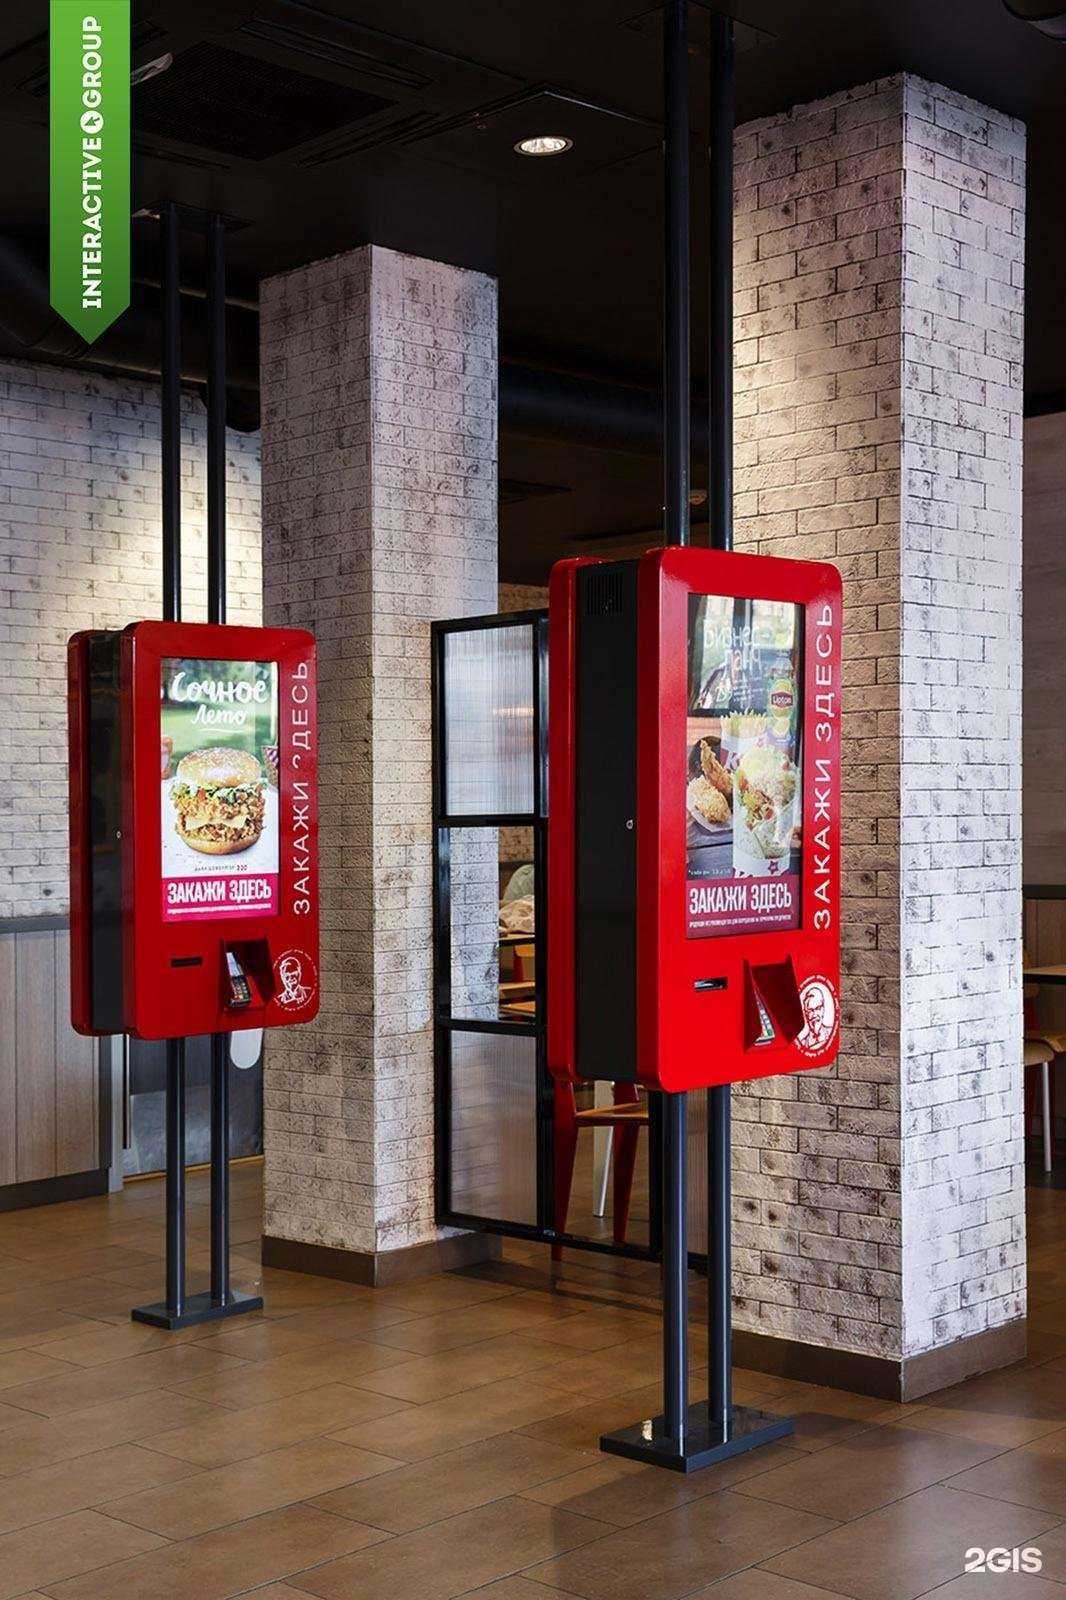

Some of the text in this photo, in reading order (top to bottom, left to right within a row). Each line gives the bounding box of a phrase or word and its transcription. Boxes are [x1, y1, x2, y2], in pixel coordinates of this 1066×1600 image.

[171, 672, 268, 704] Сочное
[814, 605, 835, 930] ЗАКАЖИ ЗДЕСЬ
[292, 782, 309, 915] ЗАКАЖИ
[167, 879, 272, 904] ЗАКАЖИ ЗДЕСЬ
[689, 883, 792, 914] ЗАКАЖИ ЗДЕСЬ
